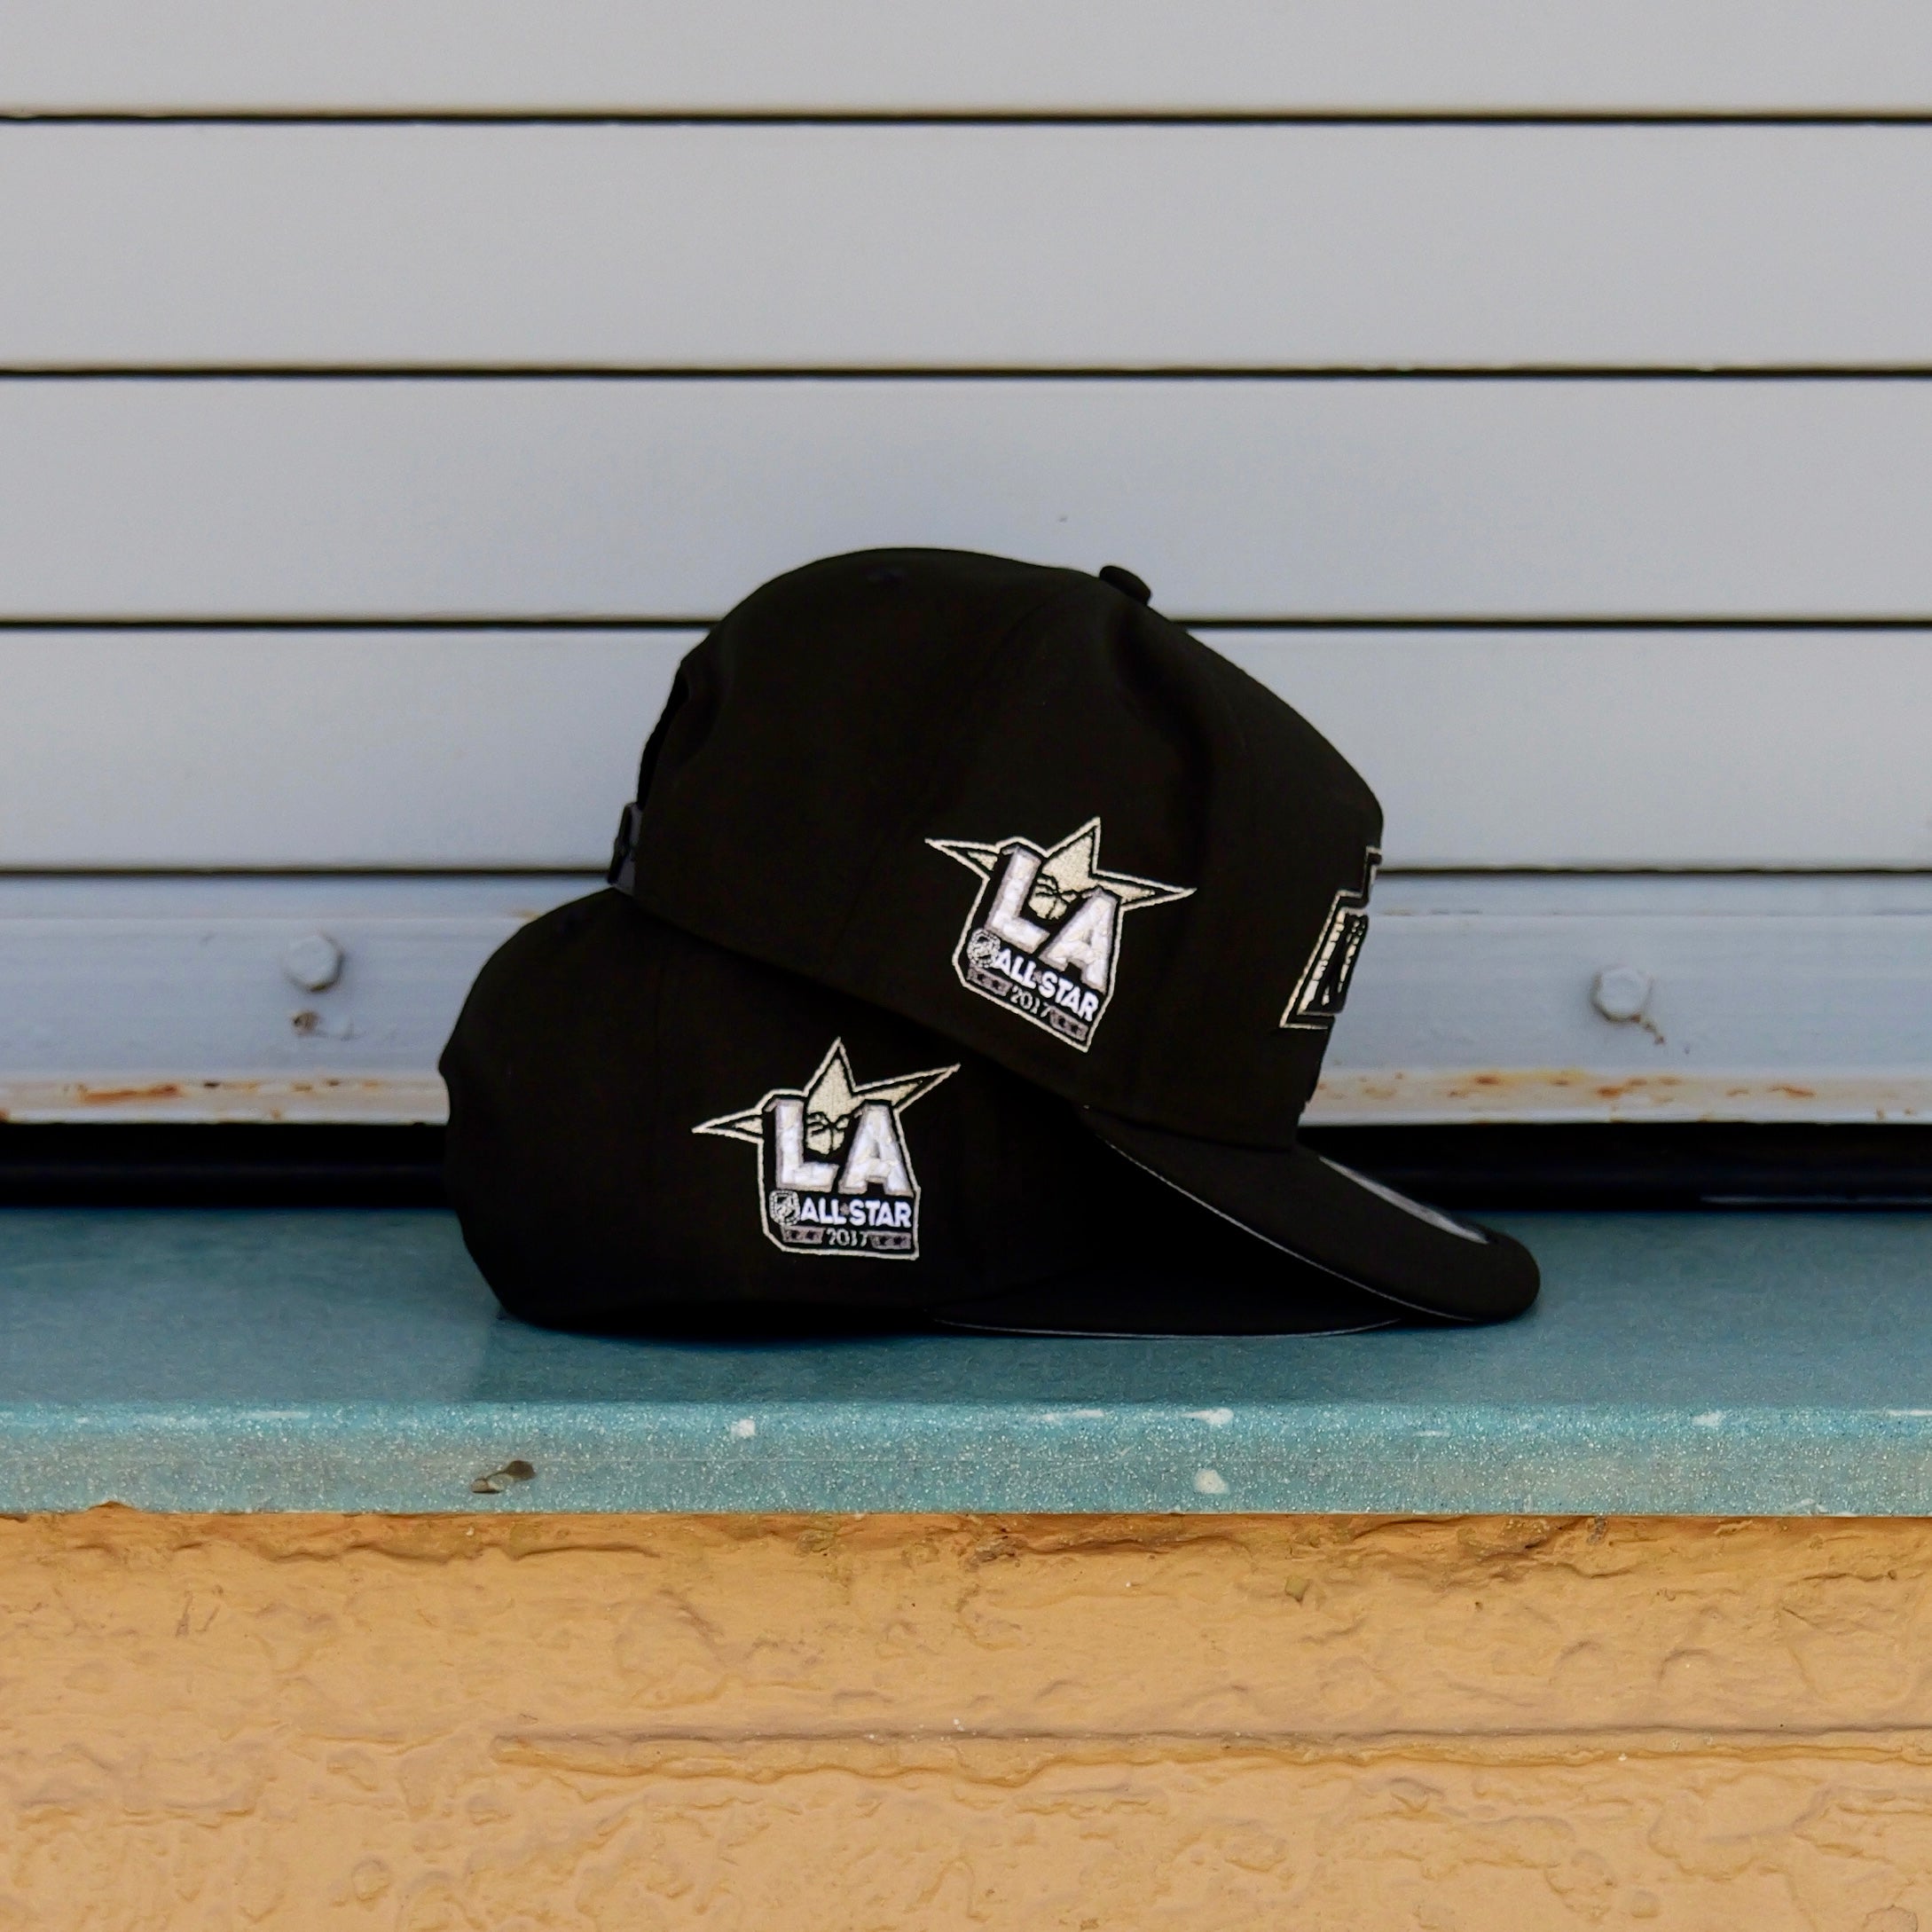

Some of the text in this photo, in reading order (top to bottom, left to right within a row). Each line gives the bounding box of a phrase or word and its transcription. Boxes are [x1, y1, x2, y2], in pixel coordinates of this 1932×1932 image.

[985, 844, 1119, 995] LA
[1009, 987, 1051, 1019] 2017
[765, 1097, 915, 1197] LA
[826, 1228, 868, 1247] 2017
